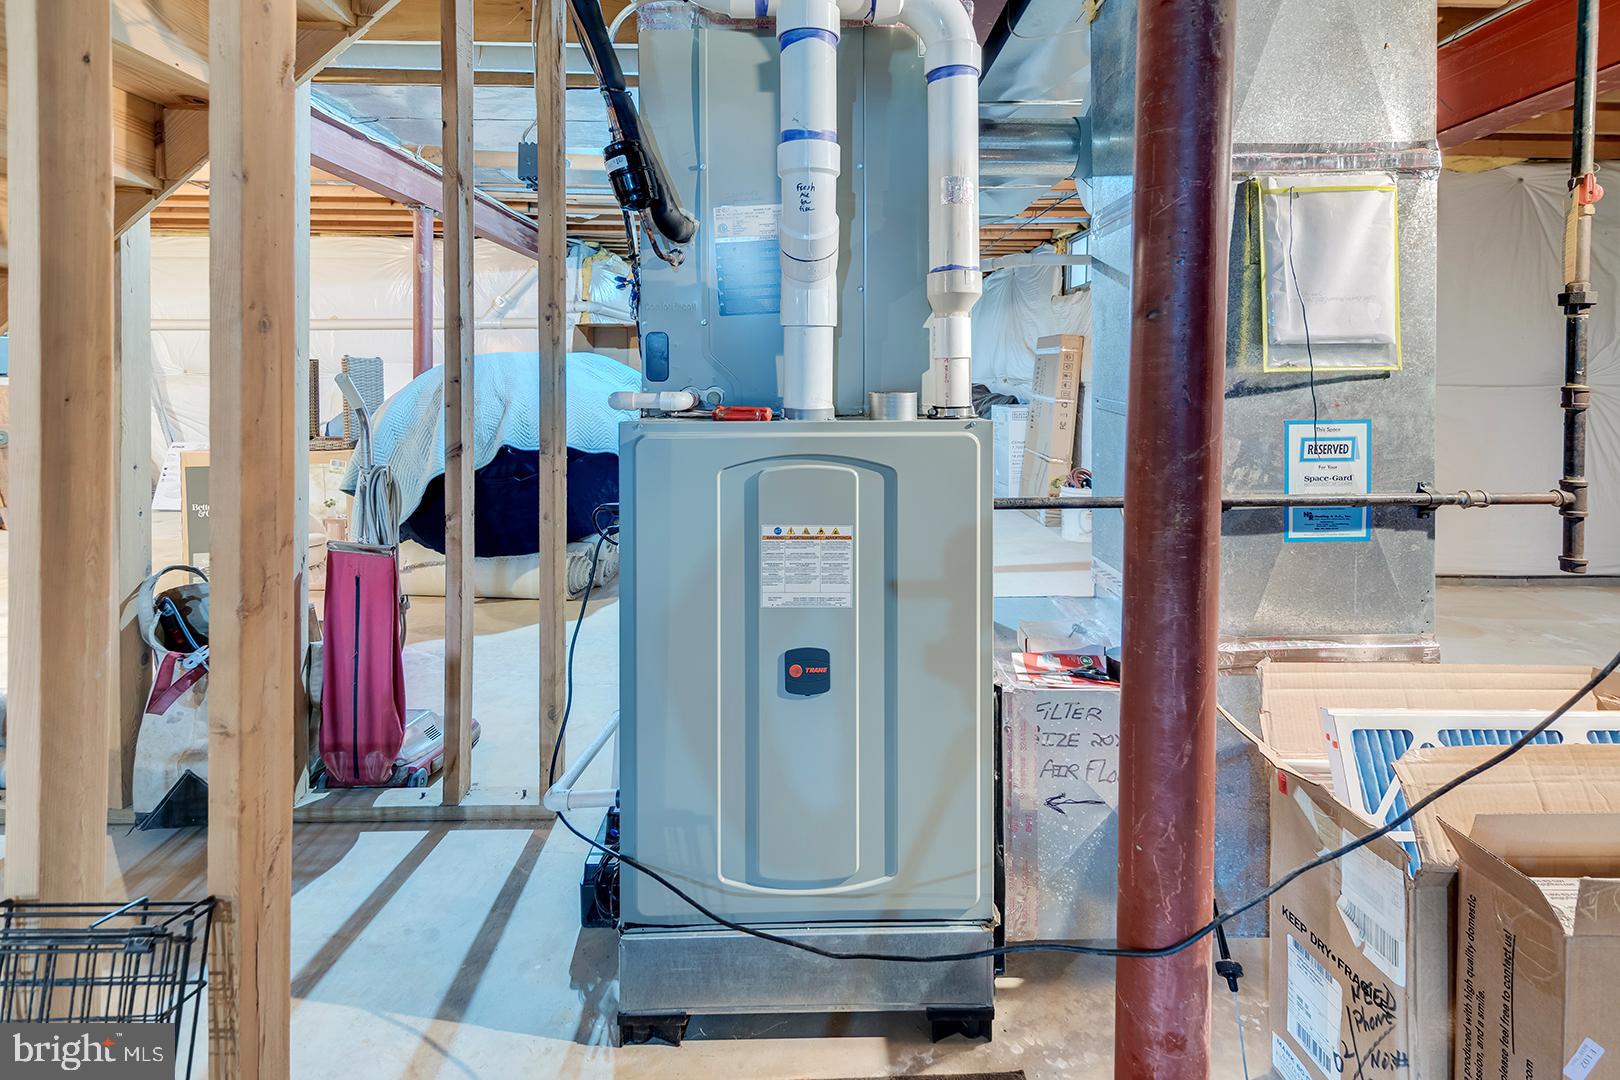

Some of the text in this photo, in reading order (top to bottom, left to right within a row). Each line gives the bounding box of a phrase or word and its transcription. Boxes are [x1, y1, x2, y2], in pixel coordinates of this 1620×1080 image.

[1307, 444, 1349, 455] RESERVED
[1036, 701, 1103, 722] FILTER
[1039, 758, 1119, 784] AIR FLO
[1282, 905, 1308, 933] KEEP
[1503, 928, 1513, 948] us!
[1502, 947, 1512, 990] contact
[1462, 894, 1477, 1079] produced with high quality domestic
[1502, 990, 1511, 1003] to
[1475, 990, 1485, 1020] smile.
[1500, 1003, 1510, 1026] free
[1478, 1020, 1484, 1028] a
[1499, 1023, 1509, 1048] feel
[1475, 1025, 1484, 1050] and
